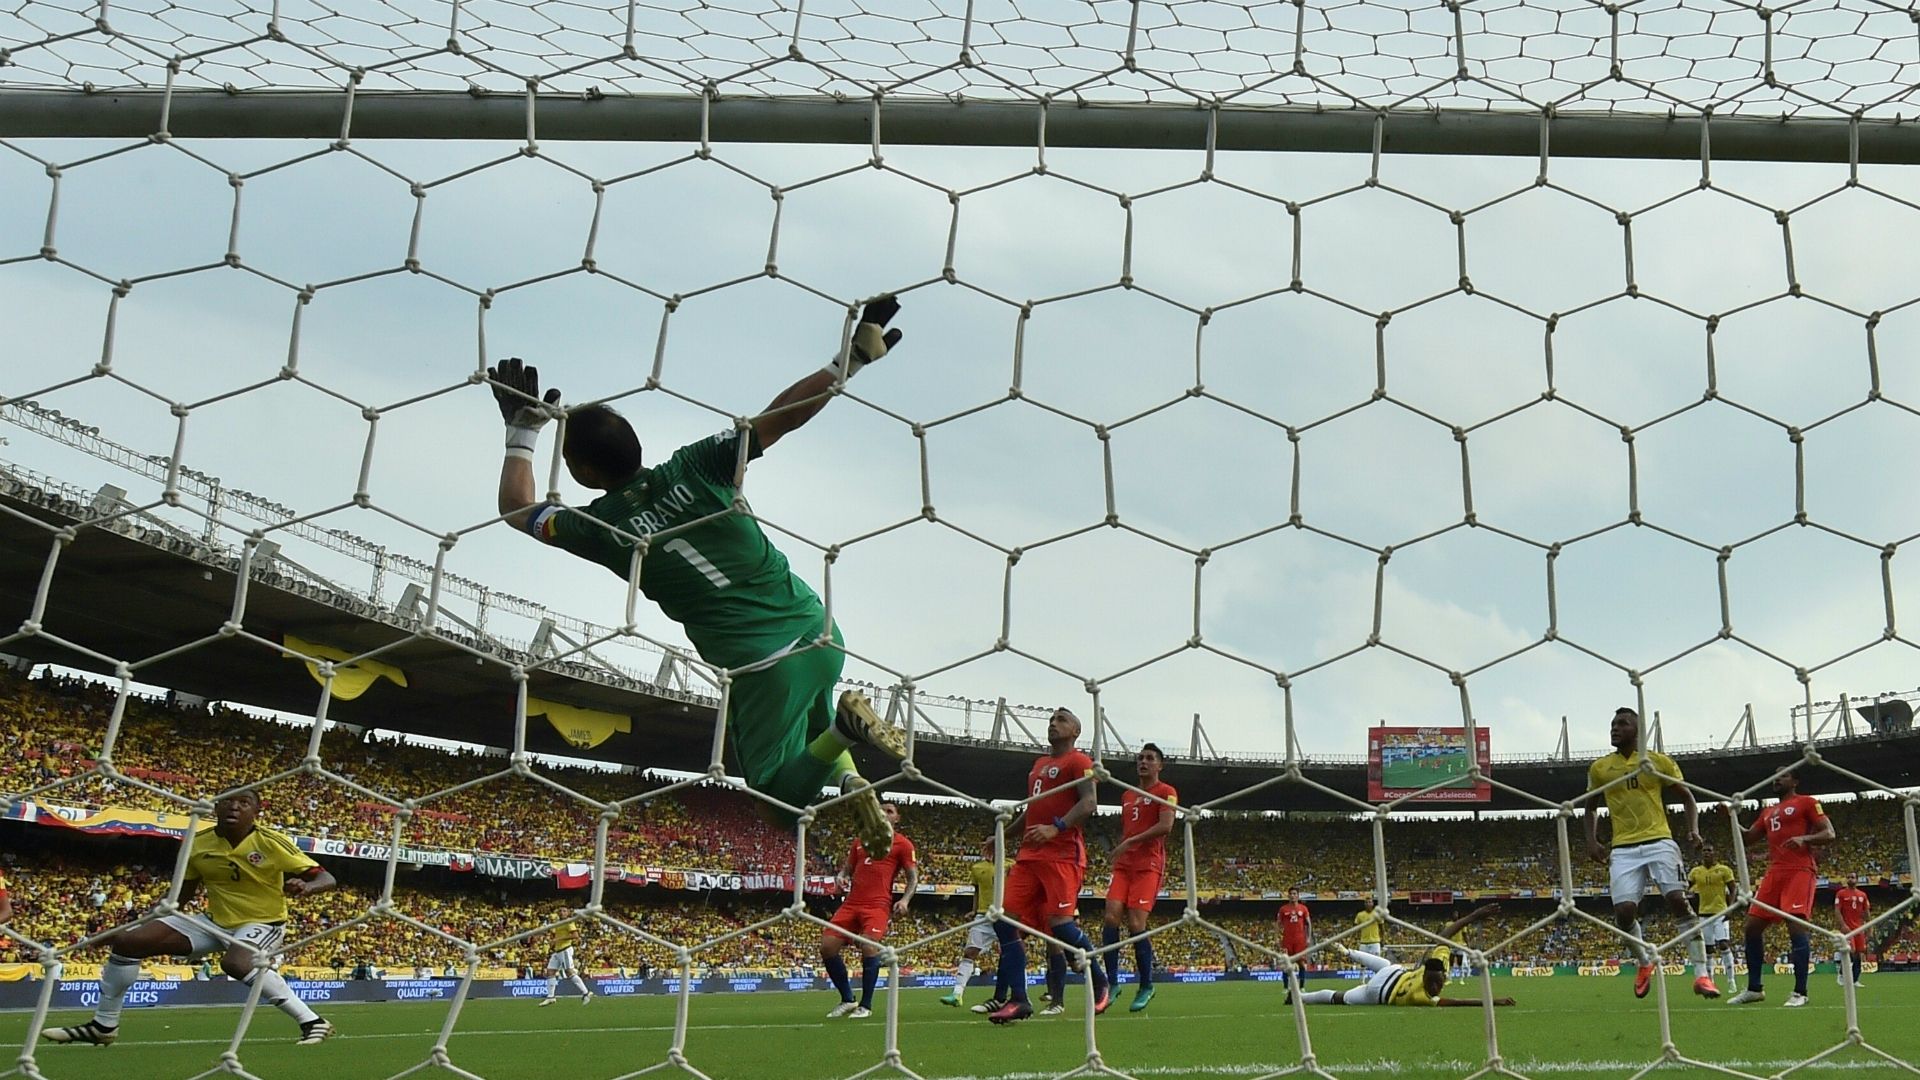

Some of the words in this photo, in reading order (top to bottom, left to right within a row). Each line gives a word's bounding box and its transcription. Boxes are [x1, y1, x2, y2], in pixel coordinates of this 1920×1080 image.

[629, 483, 695, 536] BRAVO
[662, 538, 732, 589] 1
[1032, 779, 1042, 797] 8
[1131, 806, 1139, 821] 3
[1770, 816, 1781, 832] 15
[228, 861, 240, 880] 3
[246, 928, 262, 939] 3
[60, 982, 80, 991] 2018
[82, 982, 100, 991] FIFA
[133, 981, 150, 990] CUP
[150, 981, 179, 990] RUSSIA
